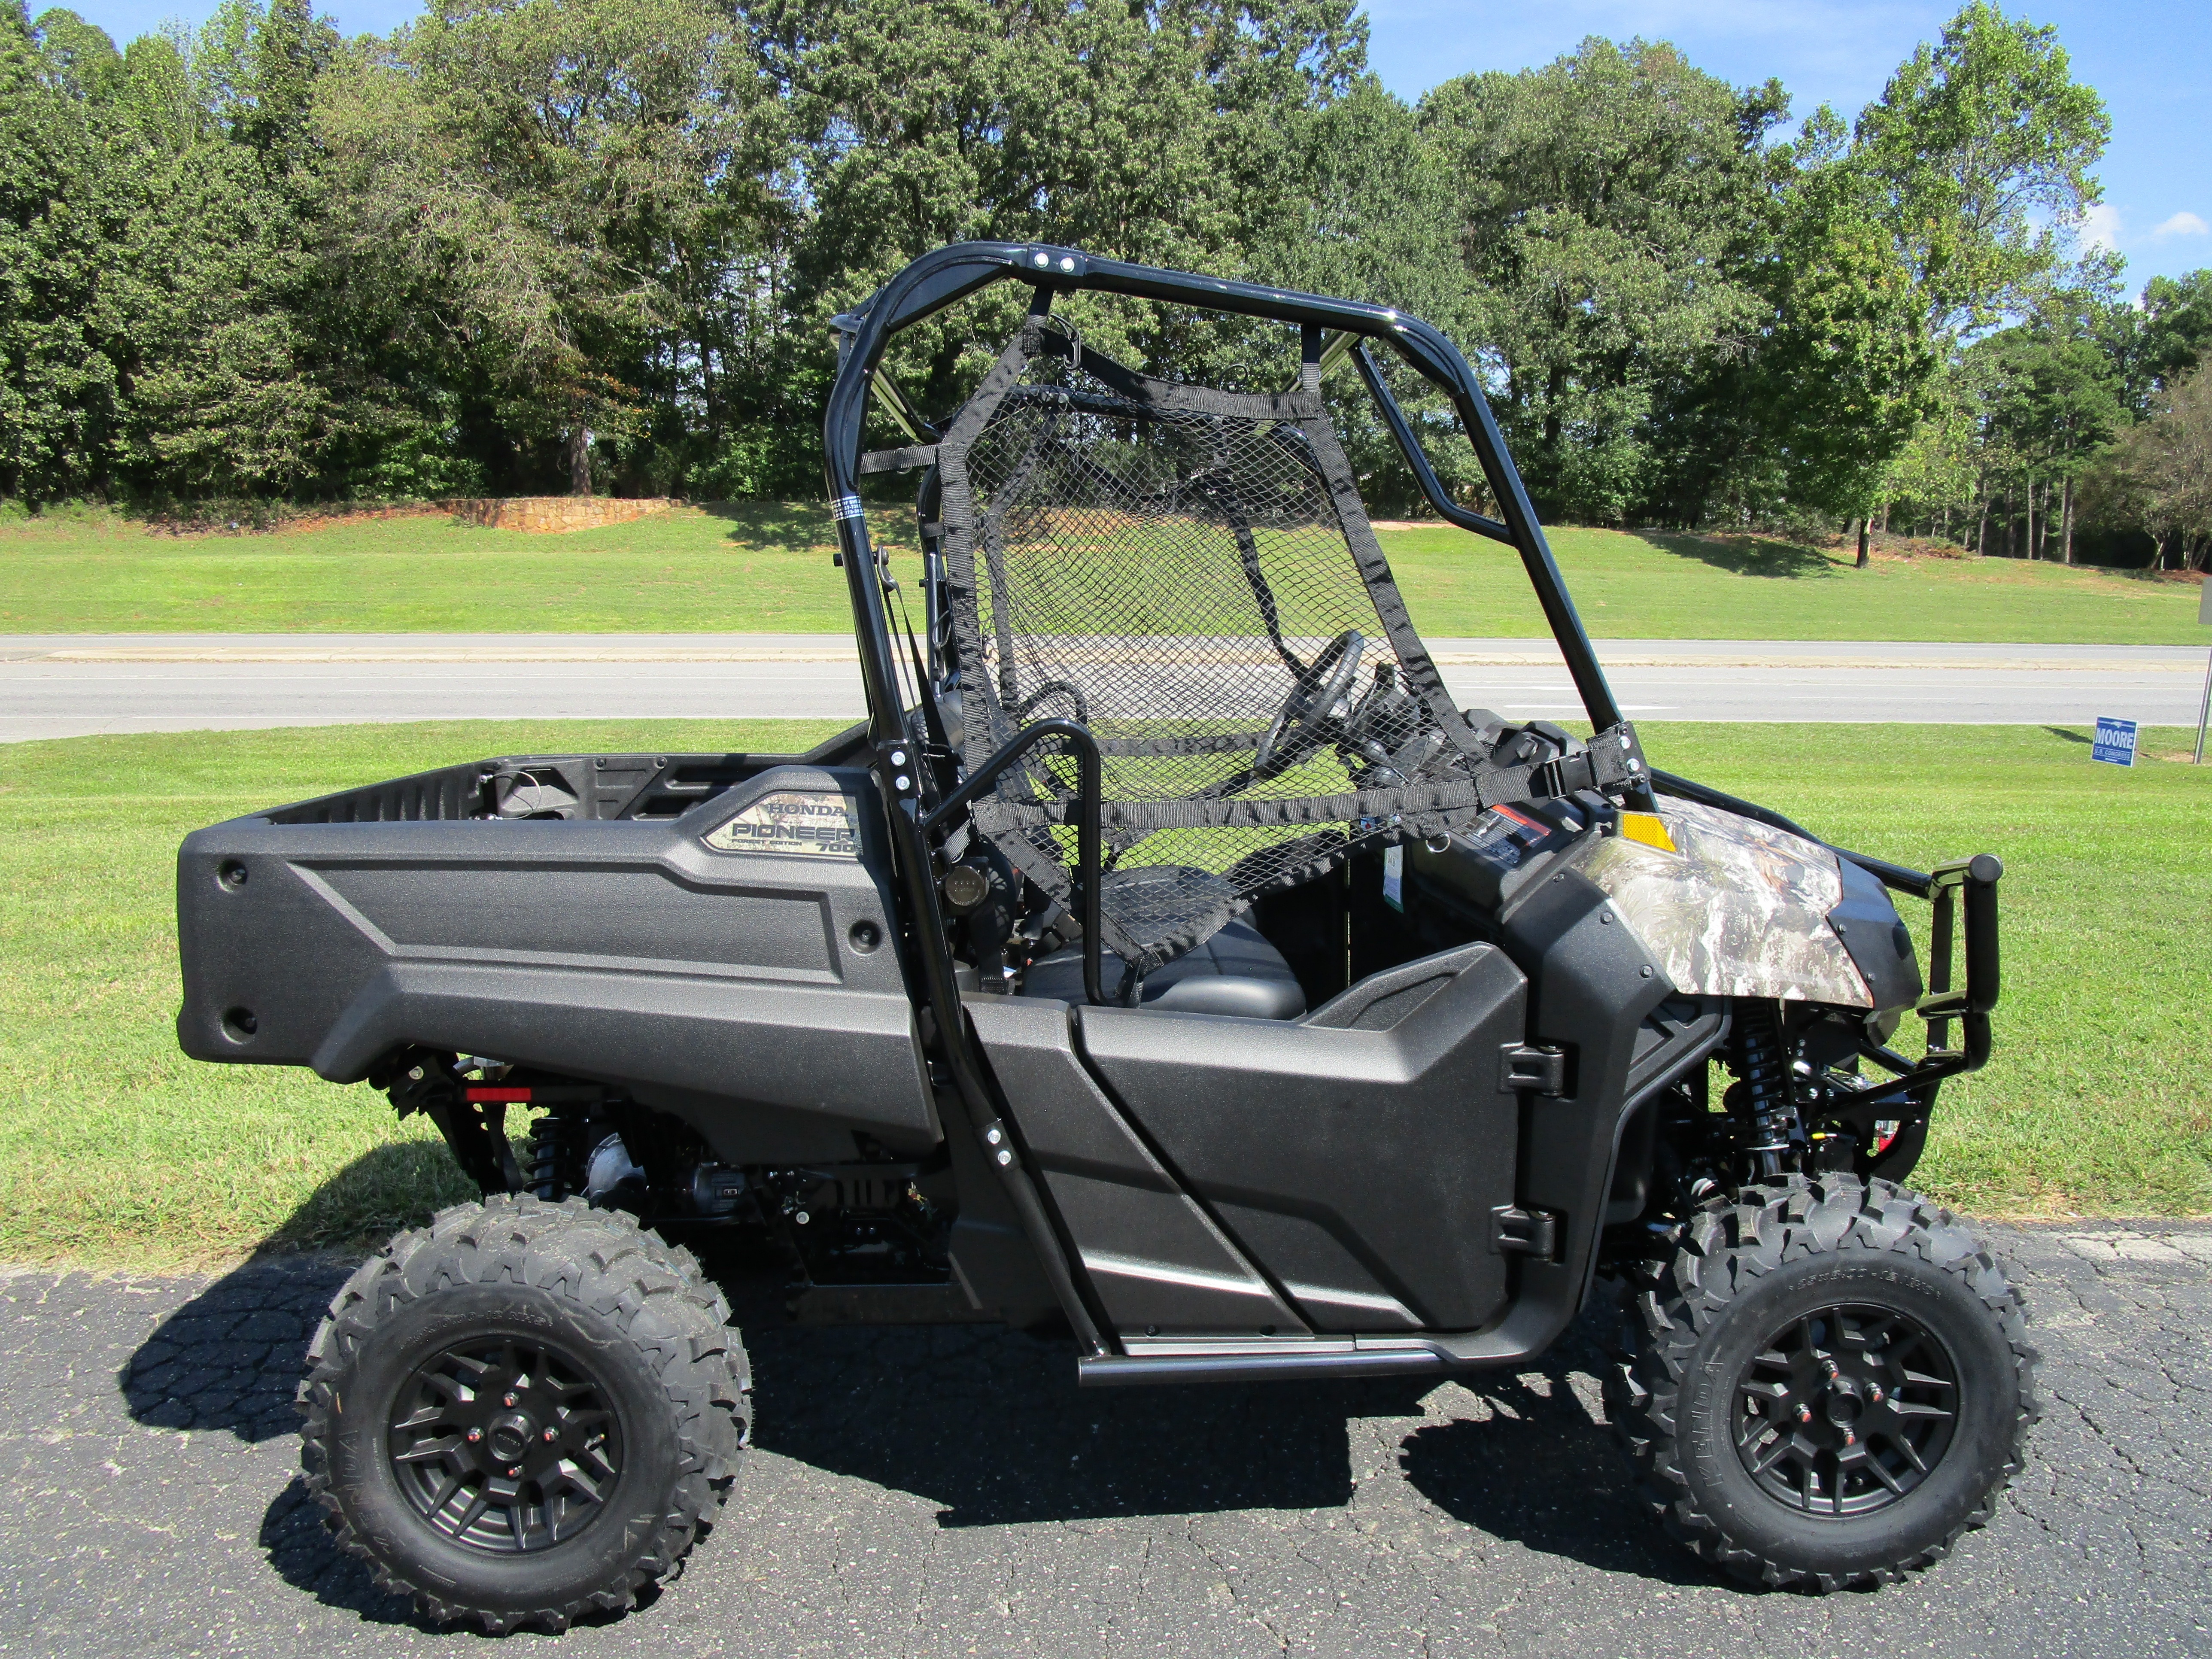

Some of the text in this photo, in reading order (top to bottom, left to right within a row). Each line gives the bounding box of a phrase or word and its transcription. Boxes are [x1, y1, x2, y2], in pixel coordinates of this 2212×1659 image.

[2095, 727, 2134, 749] MOORE
[2105, 750, 2130, 759] CONGRESS
[767, 803, 848, 817] HONDA
[732, 823, 855, 841] PIONEER
[815, 842, 856, 853] 700
[1691, 1361, 1724, 1487] KENDA
